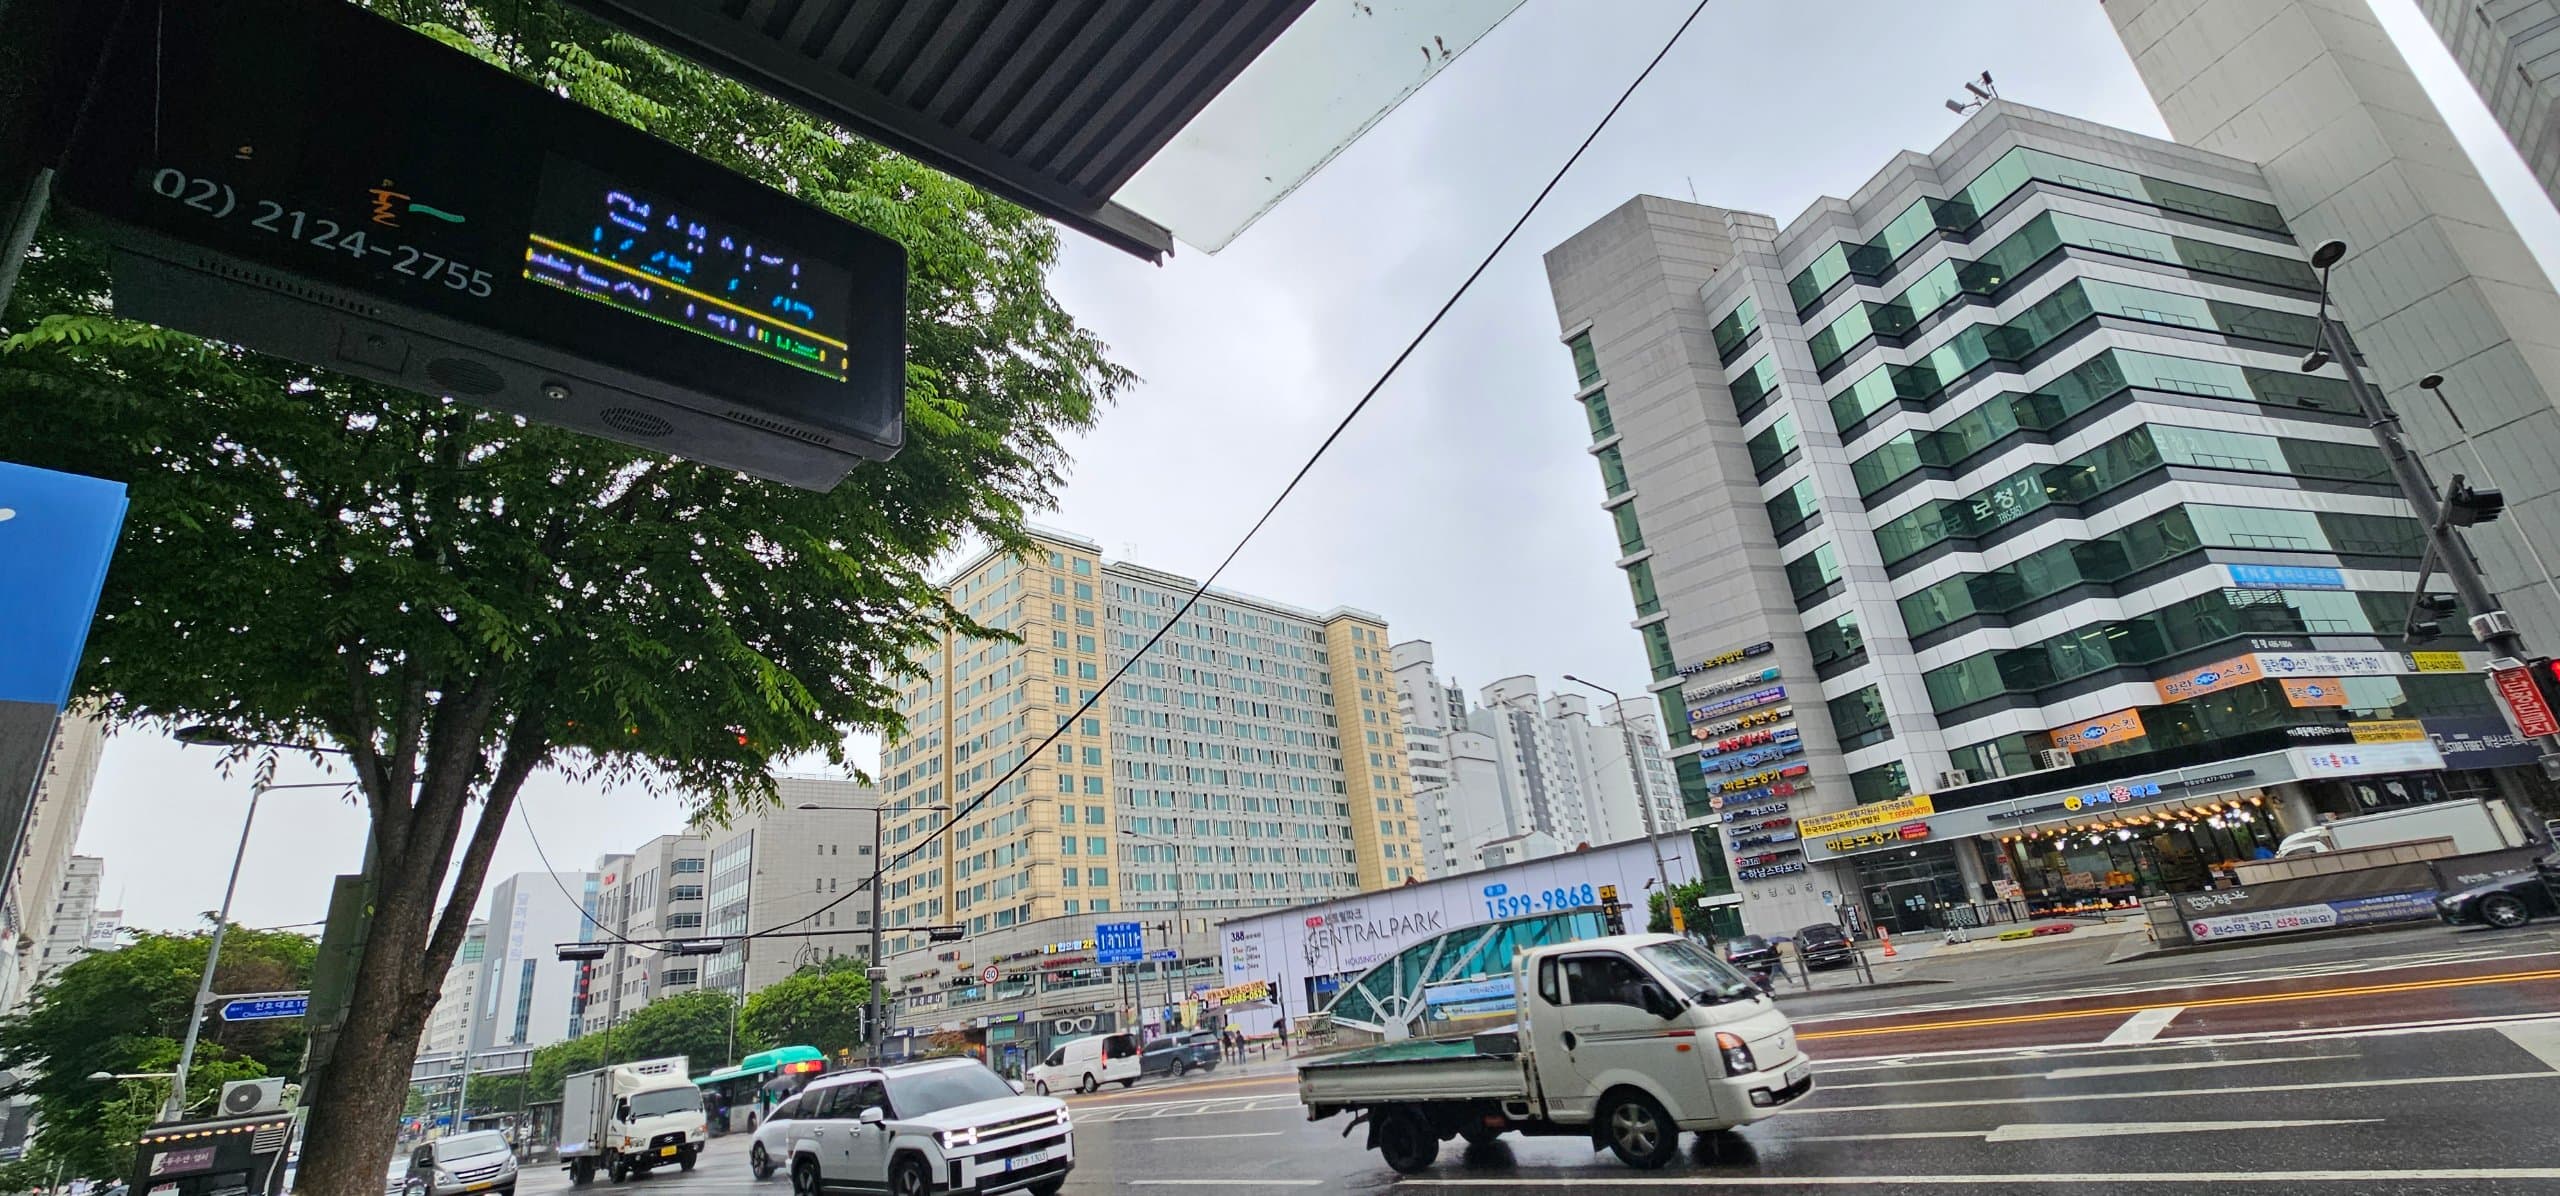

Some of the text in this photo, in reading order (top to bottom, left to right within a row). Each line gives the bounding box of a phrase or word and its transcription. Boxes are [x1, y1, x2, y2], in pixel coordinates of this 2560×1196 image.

[153, 167, 494, 298] 02) 2124-2755
[1971, 475, 2040, 521] 보청기
[2081, 780, 2163, 807] 우리홈마트
[1748, 863, 1804, 879] 하남스타포레
[1485, 883, 1595, 920] 1599-9868
[2249, 919, 2274, 932] 광고
[2275, 913, 2333, 929] 신청하세요!
[986, 970, 996, 980] 50
